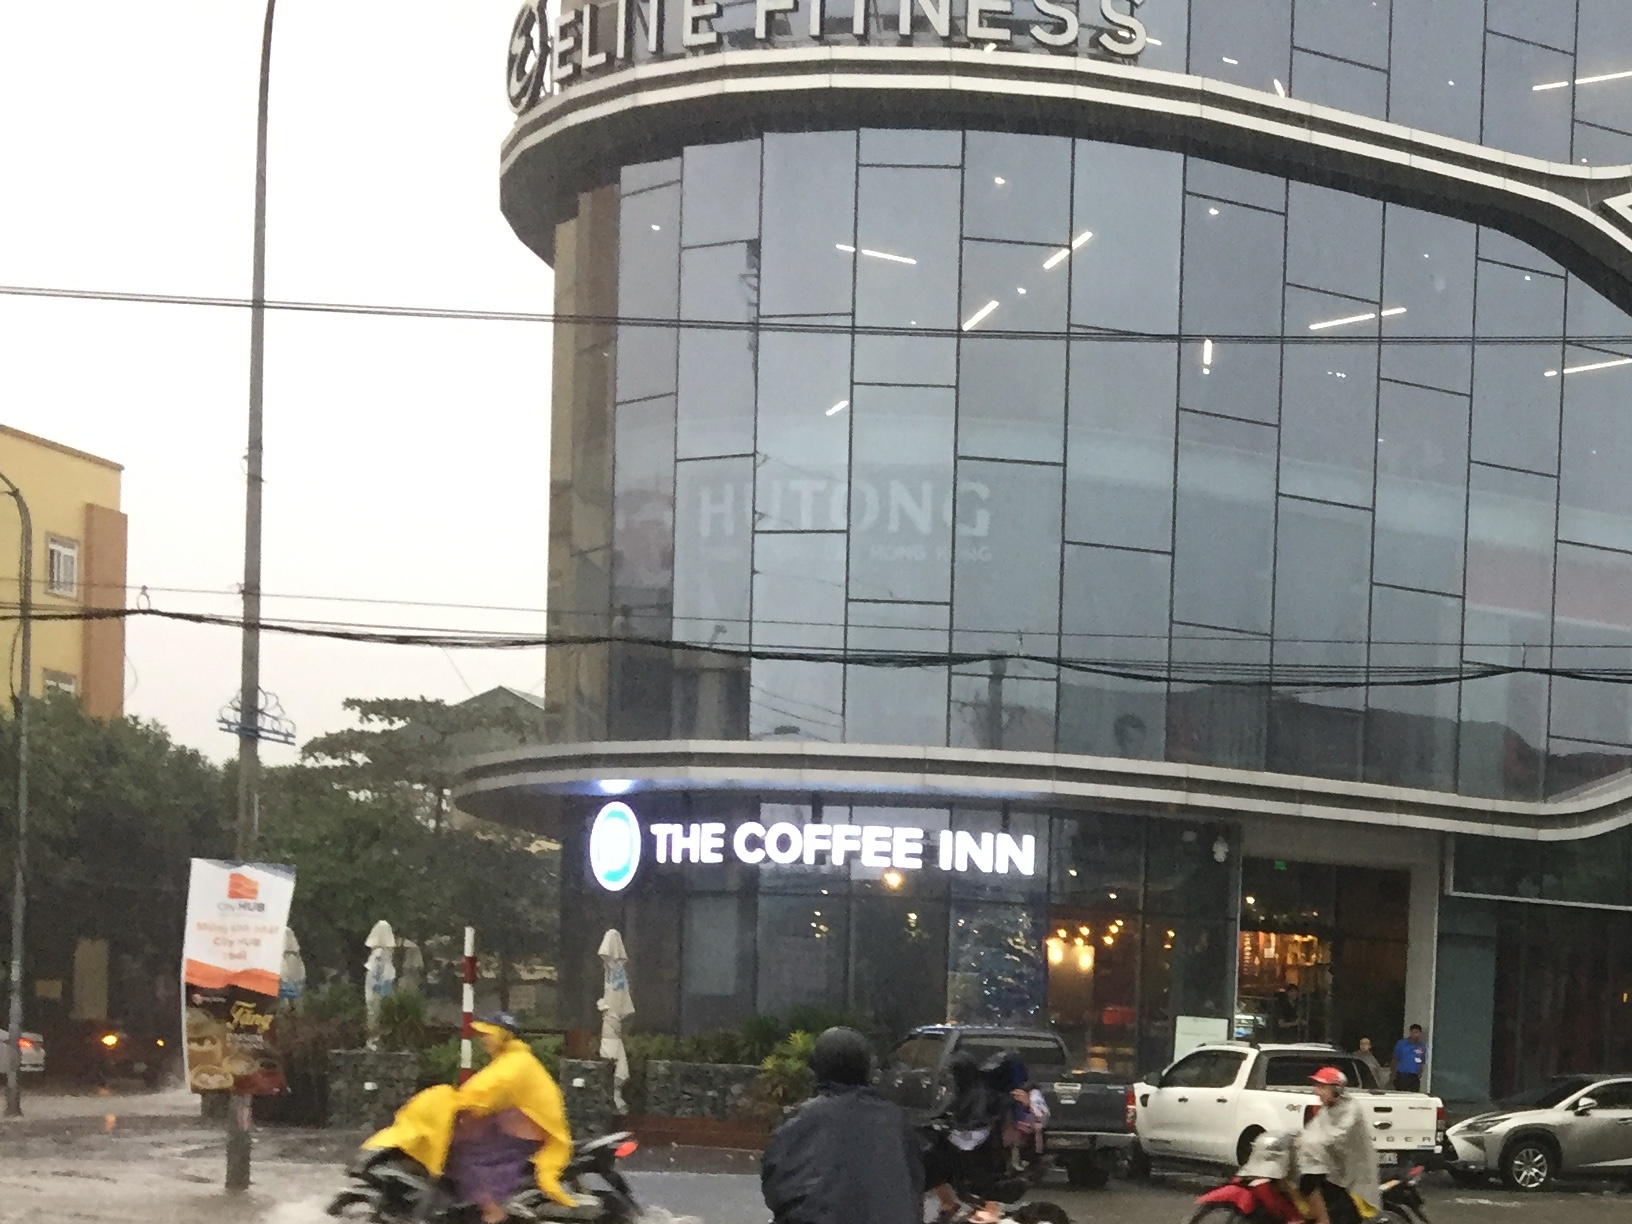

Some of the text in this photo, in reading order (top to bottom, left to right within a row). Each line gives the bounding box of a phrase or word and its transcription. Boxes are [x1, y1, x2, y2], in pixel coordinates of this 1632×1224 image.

[650, 820, 1036, 876] THE COFFEE INN
